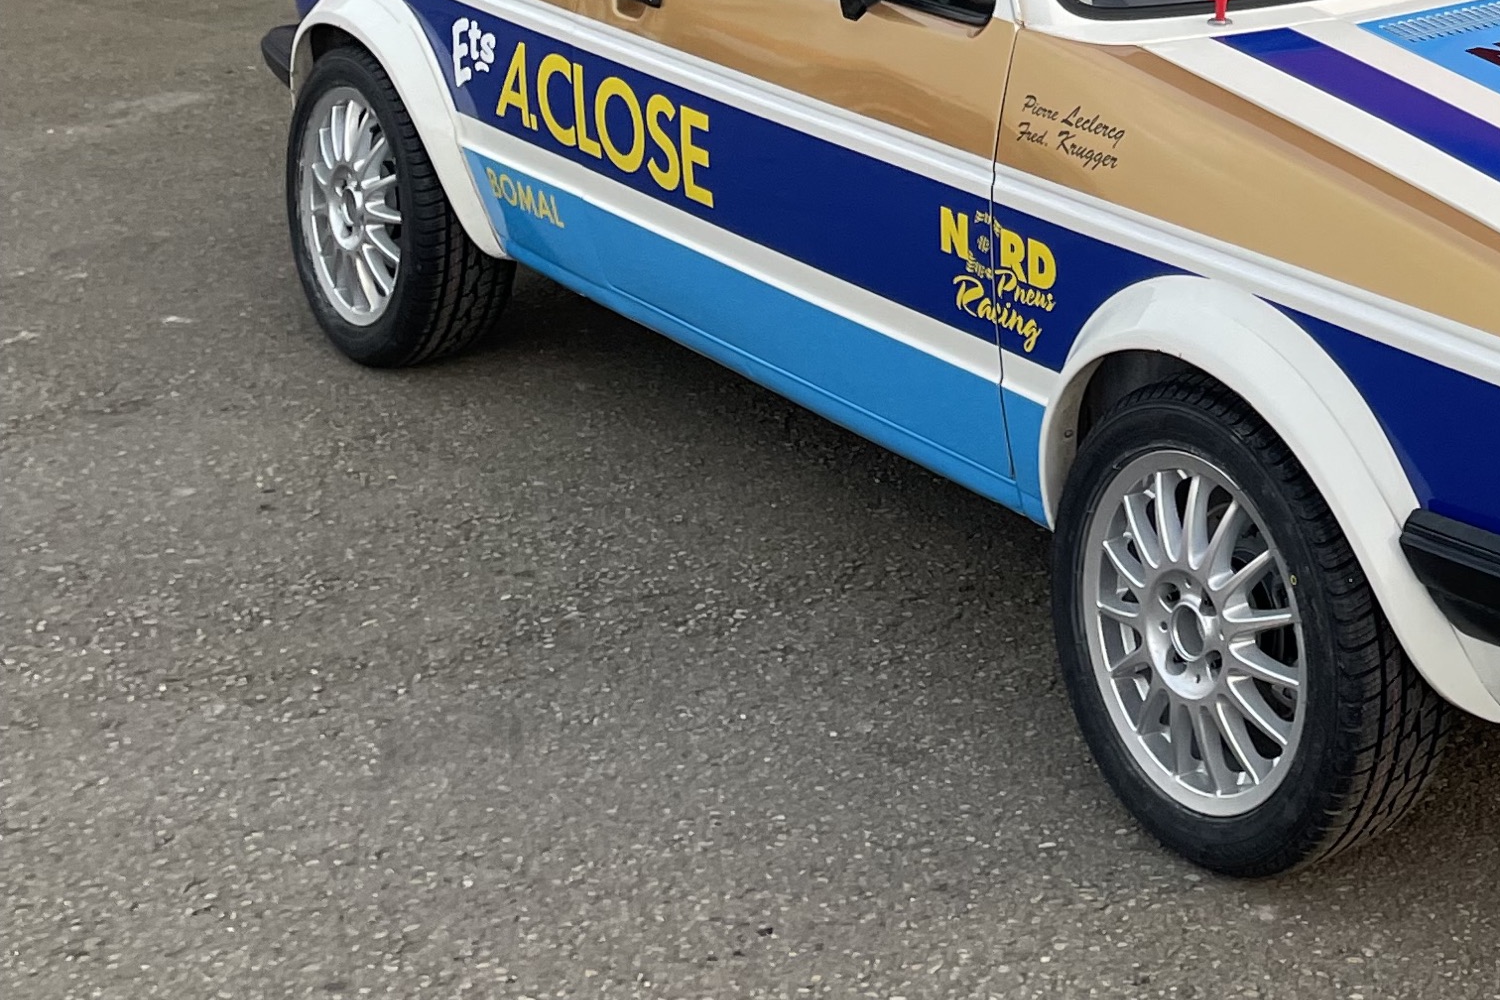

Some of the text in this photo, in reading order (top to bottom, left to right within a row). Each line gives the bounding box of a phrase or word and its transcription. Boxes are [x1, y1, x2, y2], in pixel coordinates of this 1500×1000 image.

[452, 18, 496, 87] Ets
[1016, 121, 1118, 171] Fred. Krugger
[1022, 94, 1126, 149] Pierre Leclercq
[485, 167, 564, 228] BOMAL
[953, 275, 1042, 353] Racing
[994, 269, 1056, 312] Pneus
